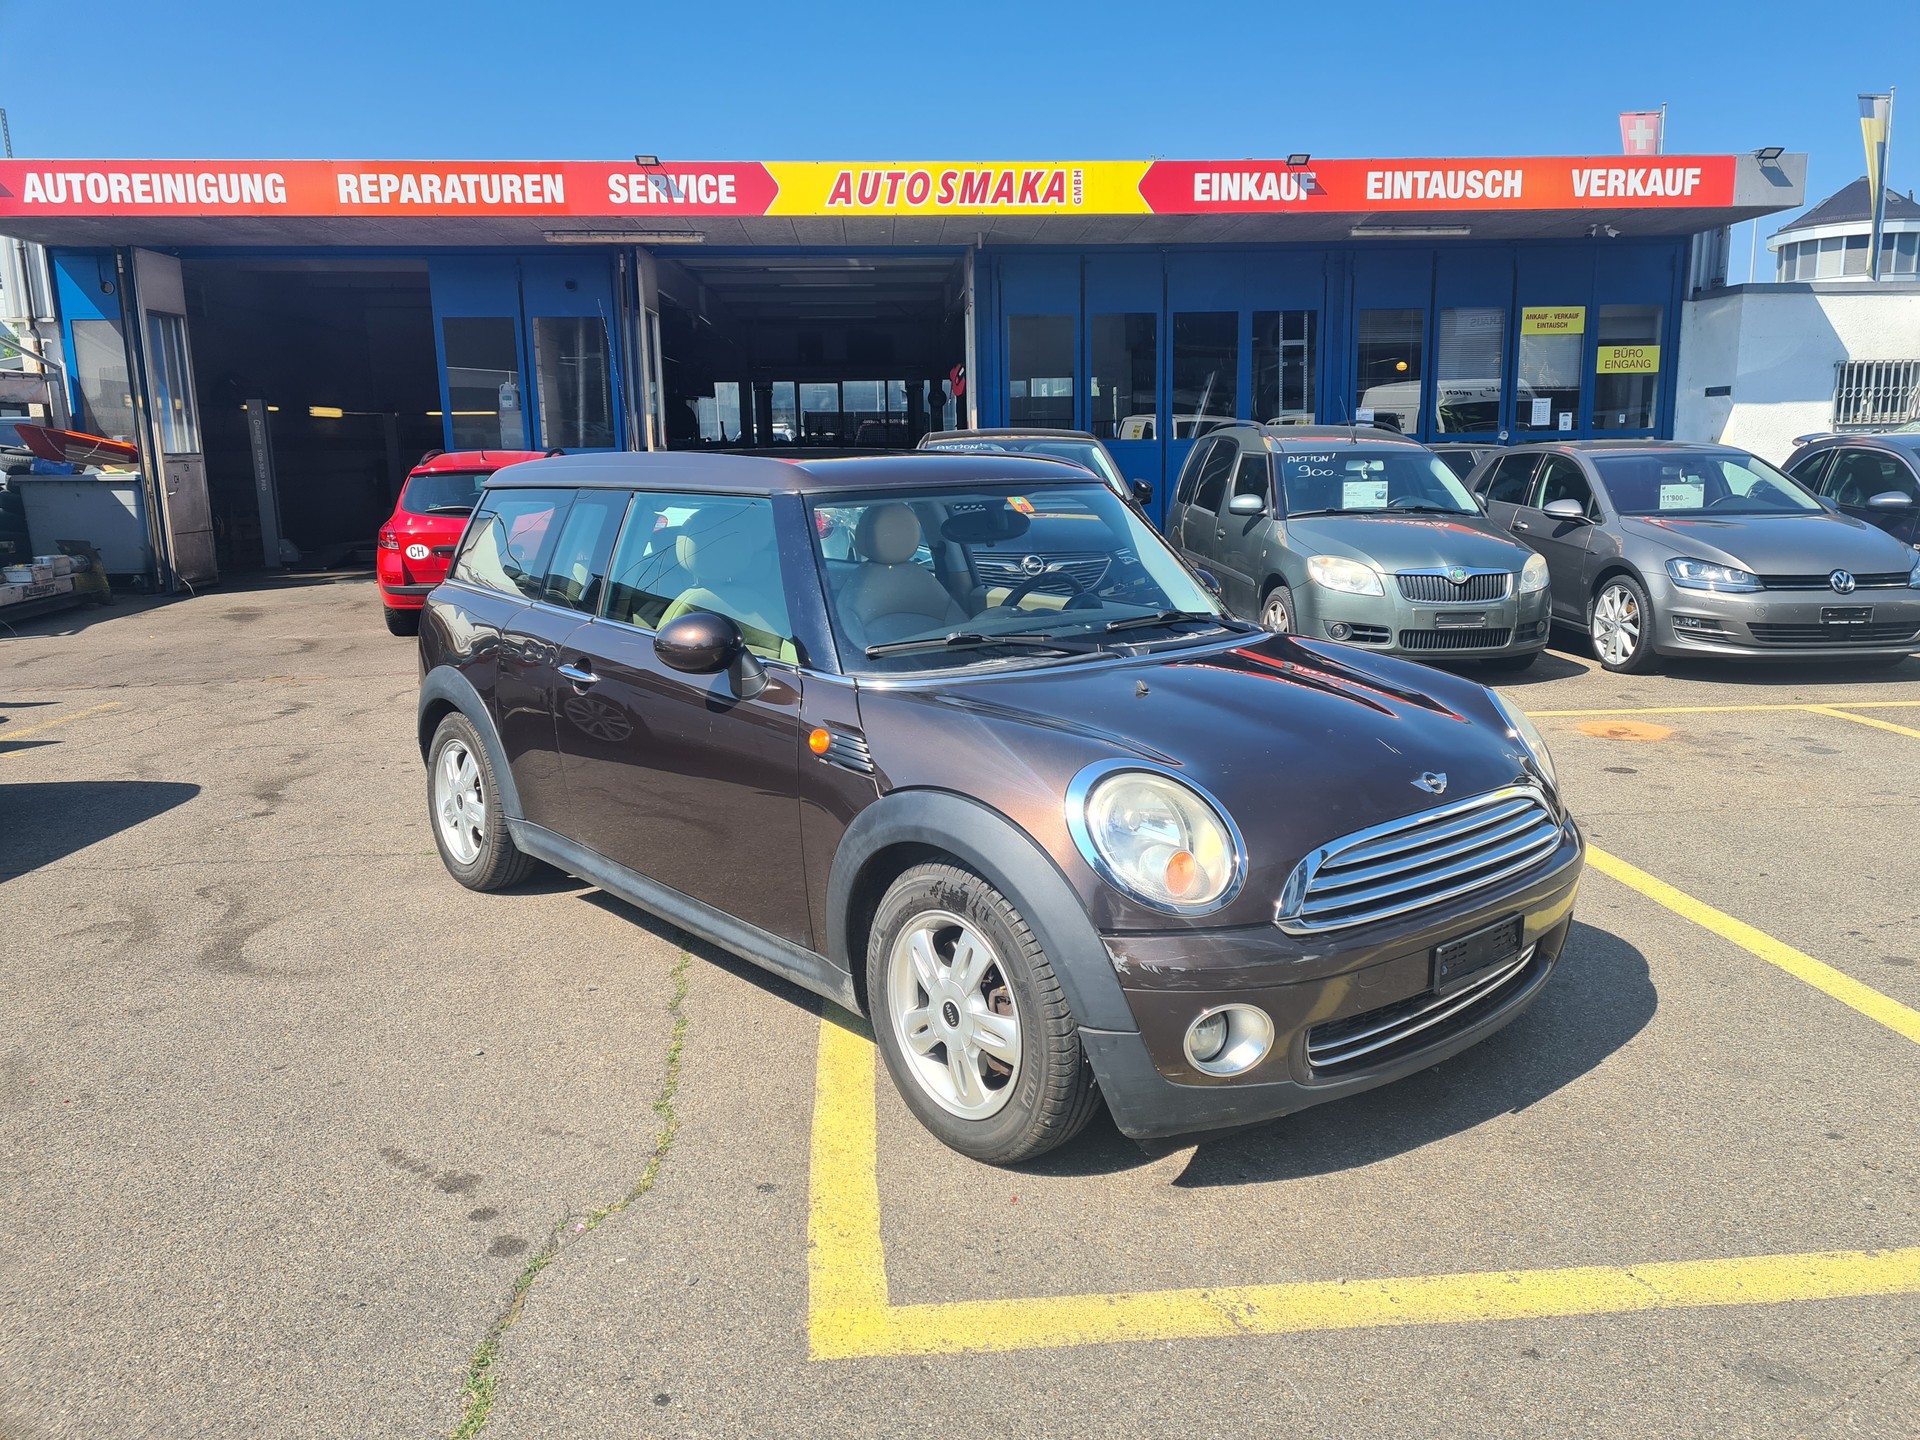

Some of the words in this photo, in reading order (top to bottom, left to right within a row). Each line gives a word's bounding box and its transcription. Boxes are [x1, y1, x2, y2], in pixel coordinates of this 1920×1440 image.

[23, 172, 287, 204] AUTOREINIGUNG
[337, 173, 566, 204] REPARATUREN
[607, 173, 737, 204] SERVICE
[827, 171, 931, 205] AUTO
[937, 170, 1066, 204] SMAKA
[1073, 169, 1083, 205] GMBH
[1193, 171, 1317, 201] EINKAUF
[1366, 169, 1523, 199] EINTAUSCH
[1571, 167, 1701, 197] VERKAUF
[1553, 312, 1580, 320] VERKAUF
[1604, 359, 1652, 369] EINGANG
[1613, 347, 1644, 359] BÜRO
[410, 546, 425, 557] CH
[945, 1003, 957, 1026] MINI
